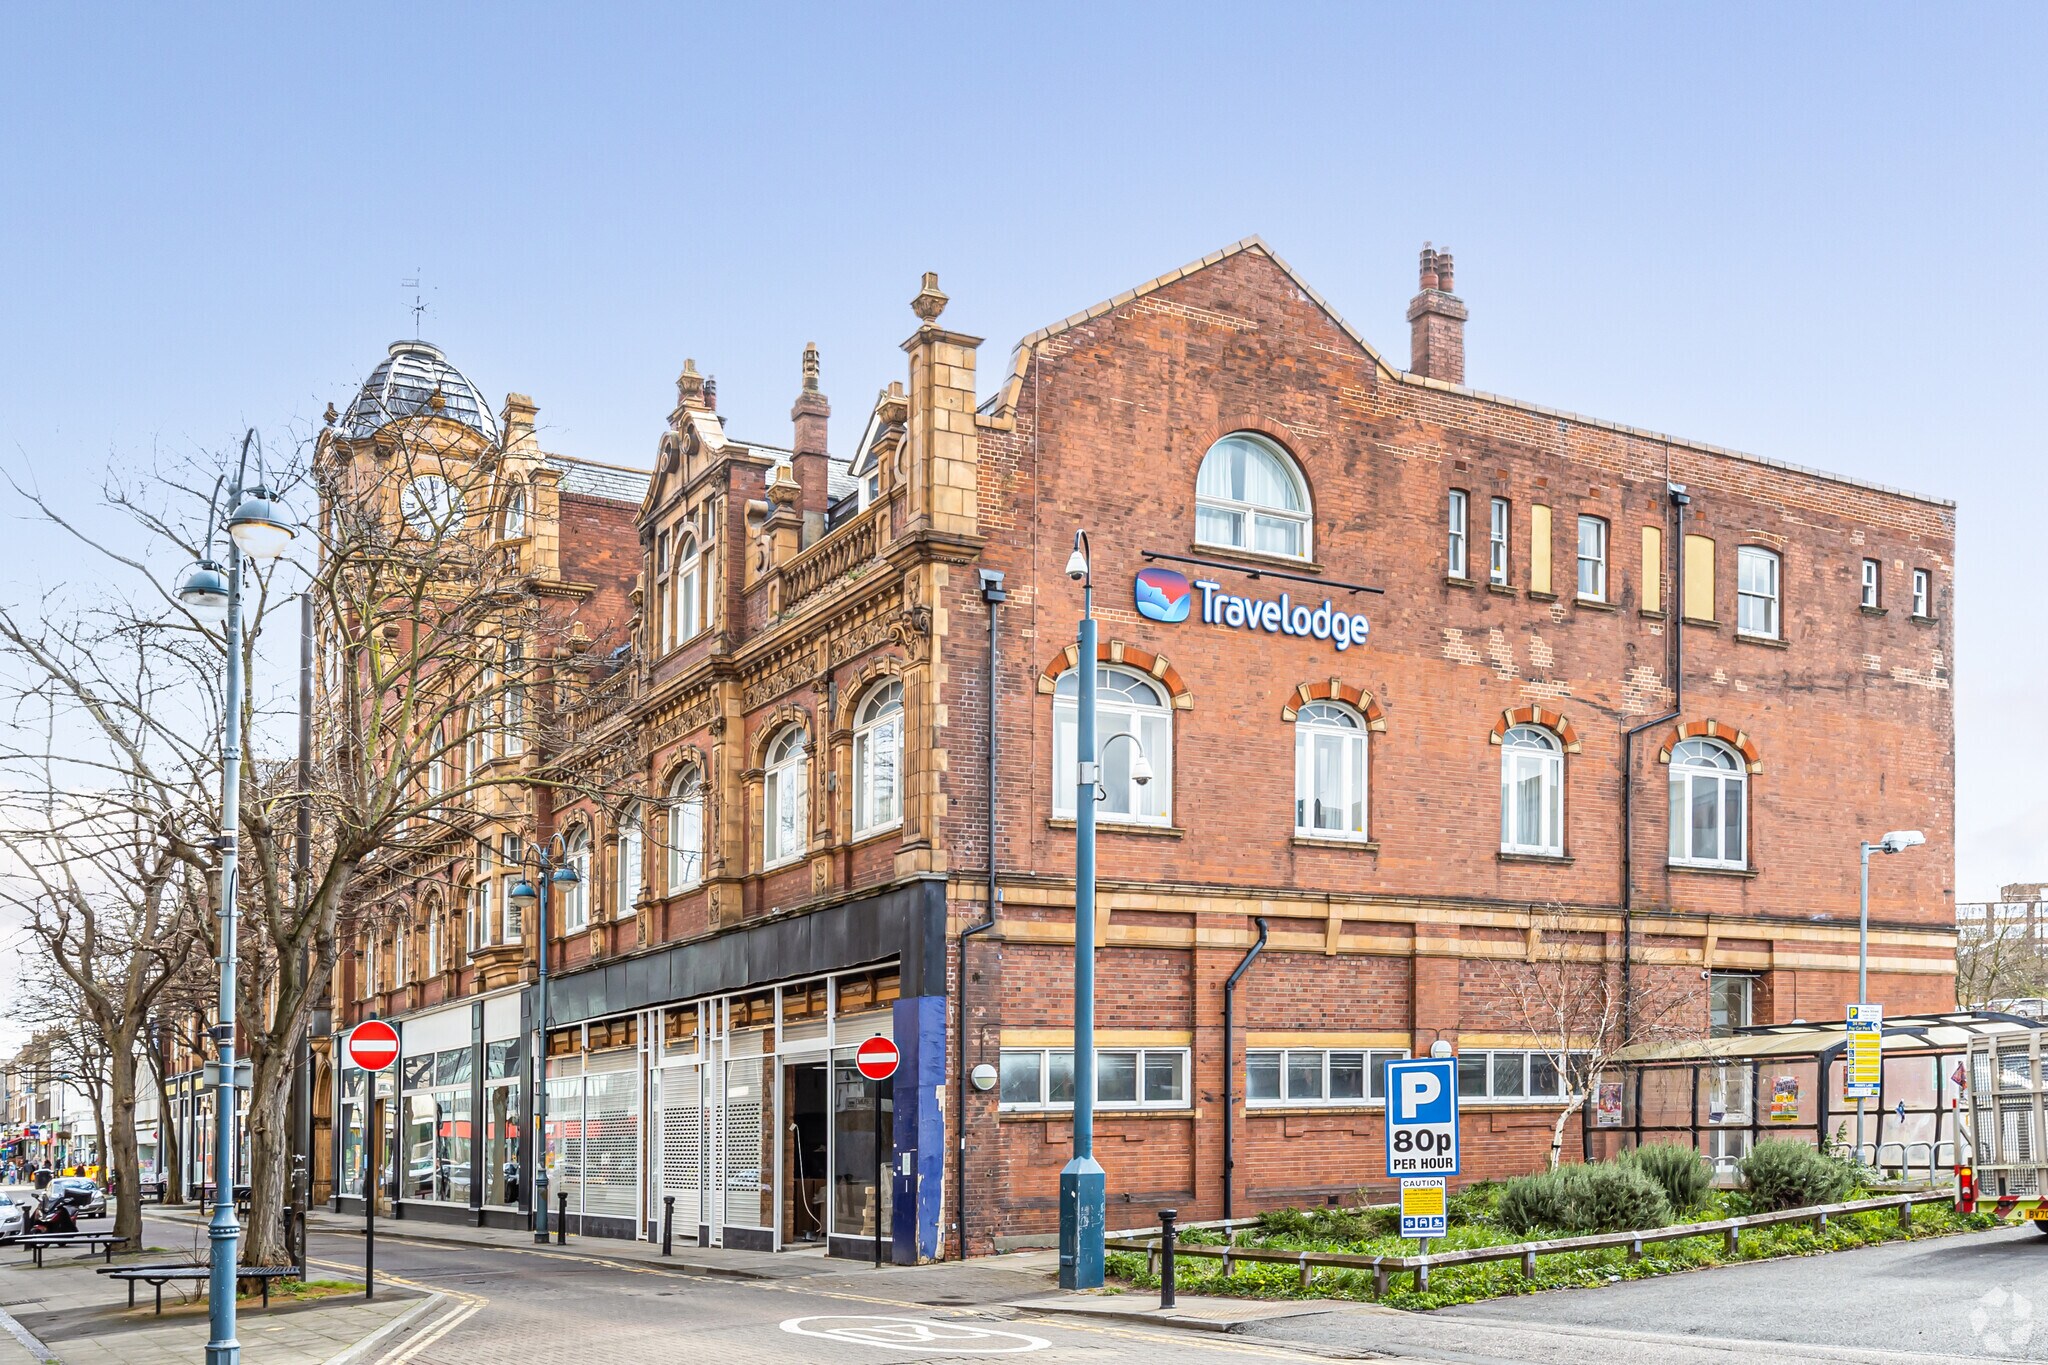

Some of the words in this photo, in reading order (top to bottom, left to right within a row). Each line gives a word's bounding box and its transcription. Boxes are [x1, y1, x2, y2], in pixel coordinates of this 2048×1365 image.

[1193, 580, 1369, 651] Travelodge
[1850, 1007, 1857, 1019] P
[1401, 1071, 1441, 1119] P
[1393, 1129, 1452, 1156] 80p
[1393, 1158, 1417, 1170] PER
[1421, 1157, 1453, 1169] HOUR
[1403, 1179, 1443, 1187] CAUTION
